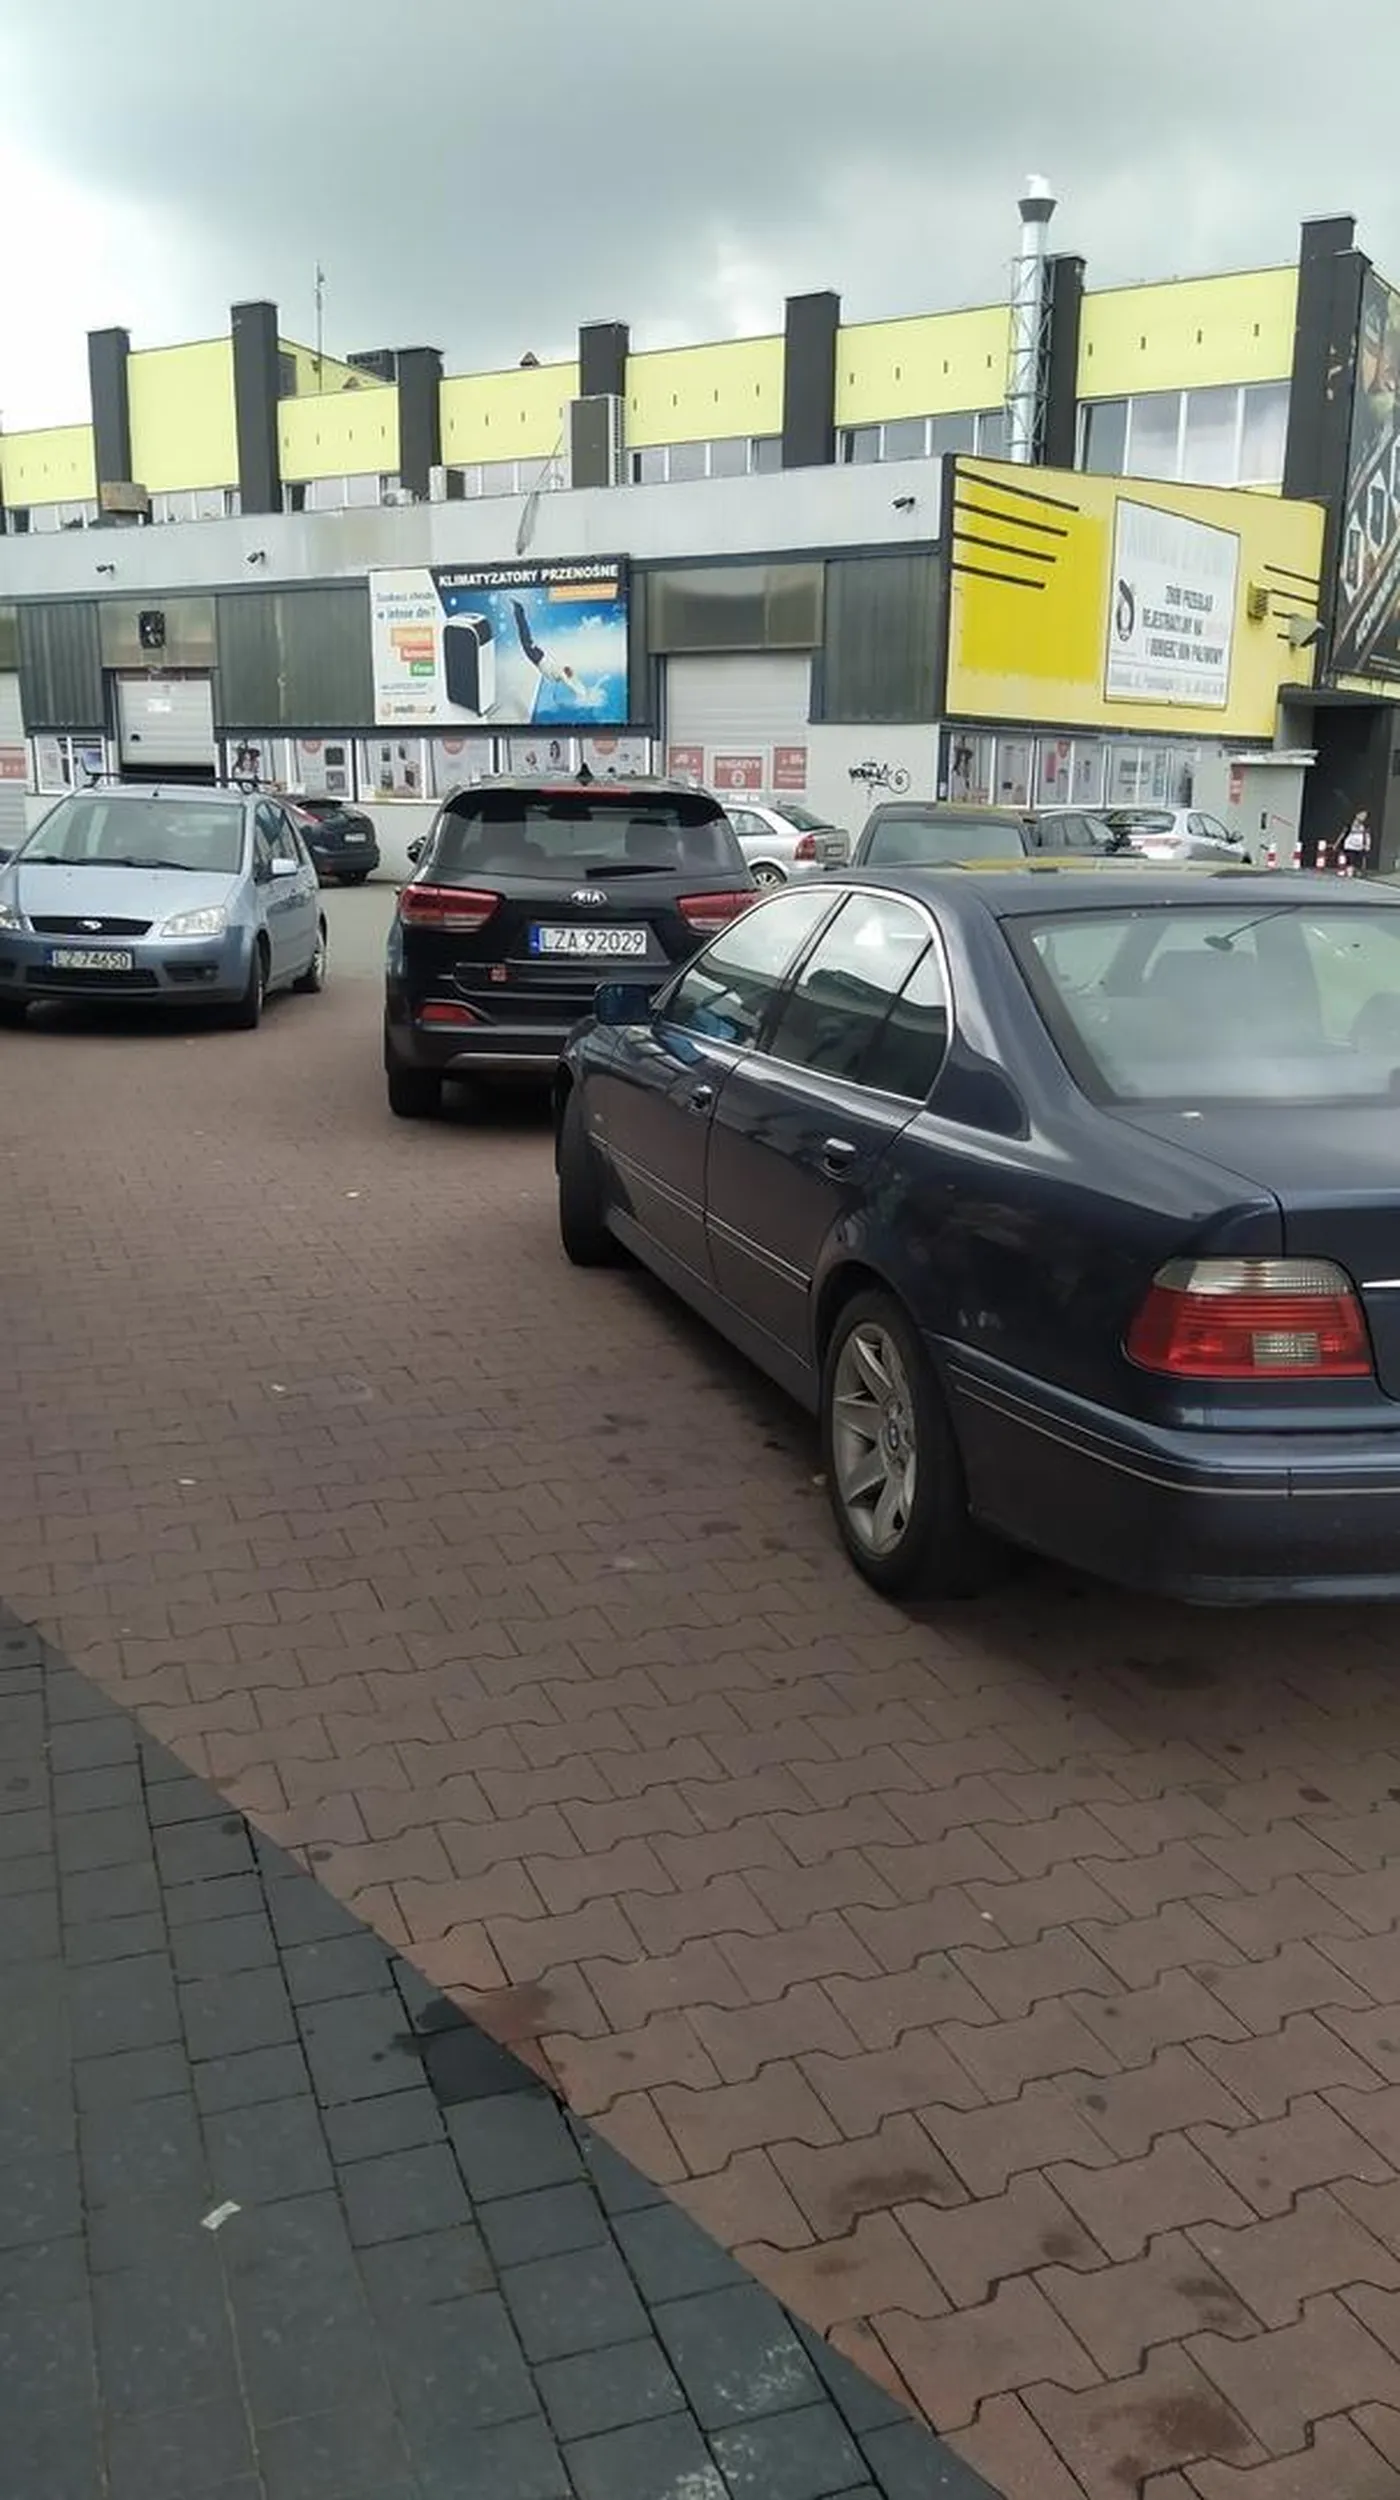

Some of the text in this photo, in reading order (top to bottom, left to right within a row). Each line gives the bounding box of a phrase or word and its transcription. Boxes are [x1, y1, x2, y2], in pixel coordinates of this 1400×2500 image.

[438, 564, 618, 587] KLIMATYZATORY PRZENOŚNE
[576, 891, 601, 902] KIA
[542, 930, 645, 951] LZA 92029
